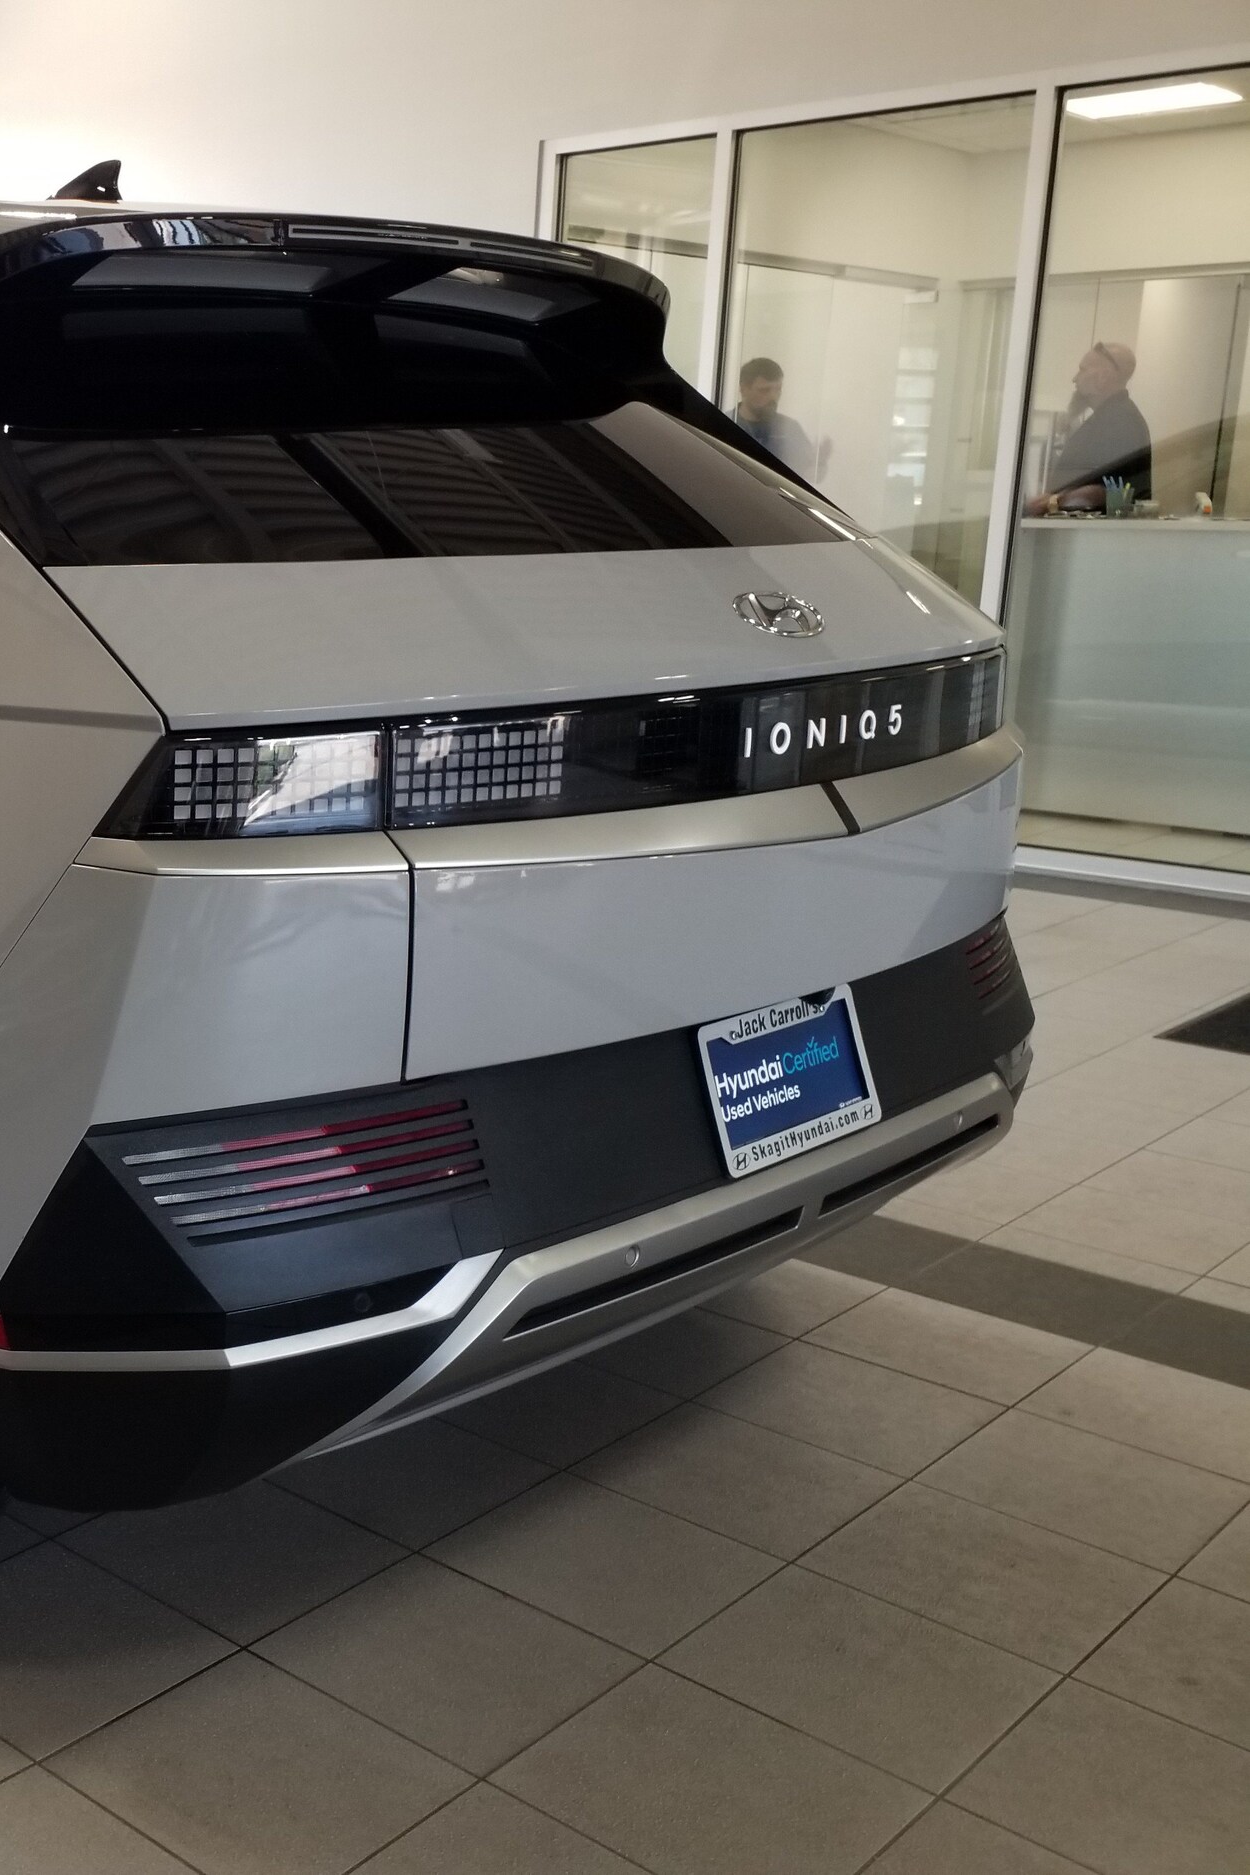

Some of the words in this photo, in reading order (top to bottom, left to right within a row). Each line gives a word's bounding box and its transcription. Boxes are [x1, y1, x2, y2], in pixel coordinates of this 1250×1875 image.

[737, 1013, 766, 1038] Jack
[715, 1055, 783, 1098] Hyundai
[783, 1036, 839, 1074] Certified
[722, 1103, 753, 1122] Used
[755, 1084, 800, 1110] Vehicles
[752, 1109, 859, 1161] SkagitHyundai.com
